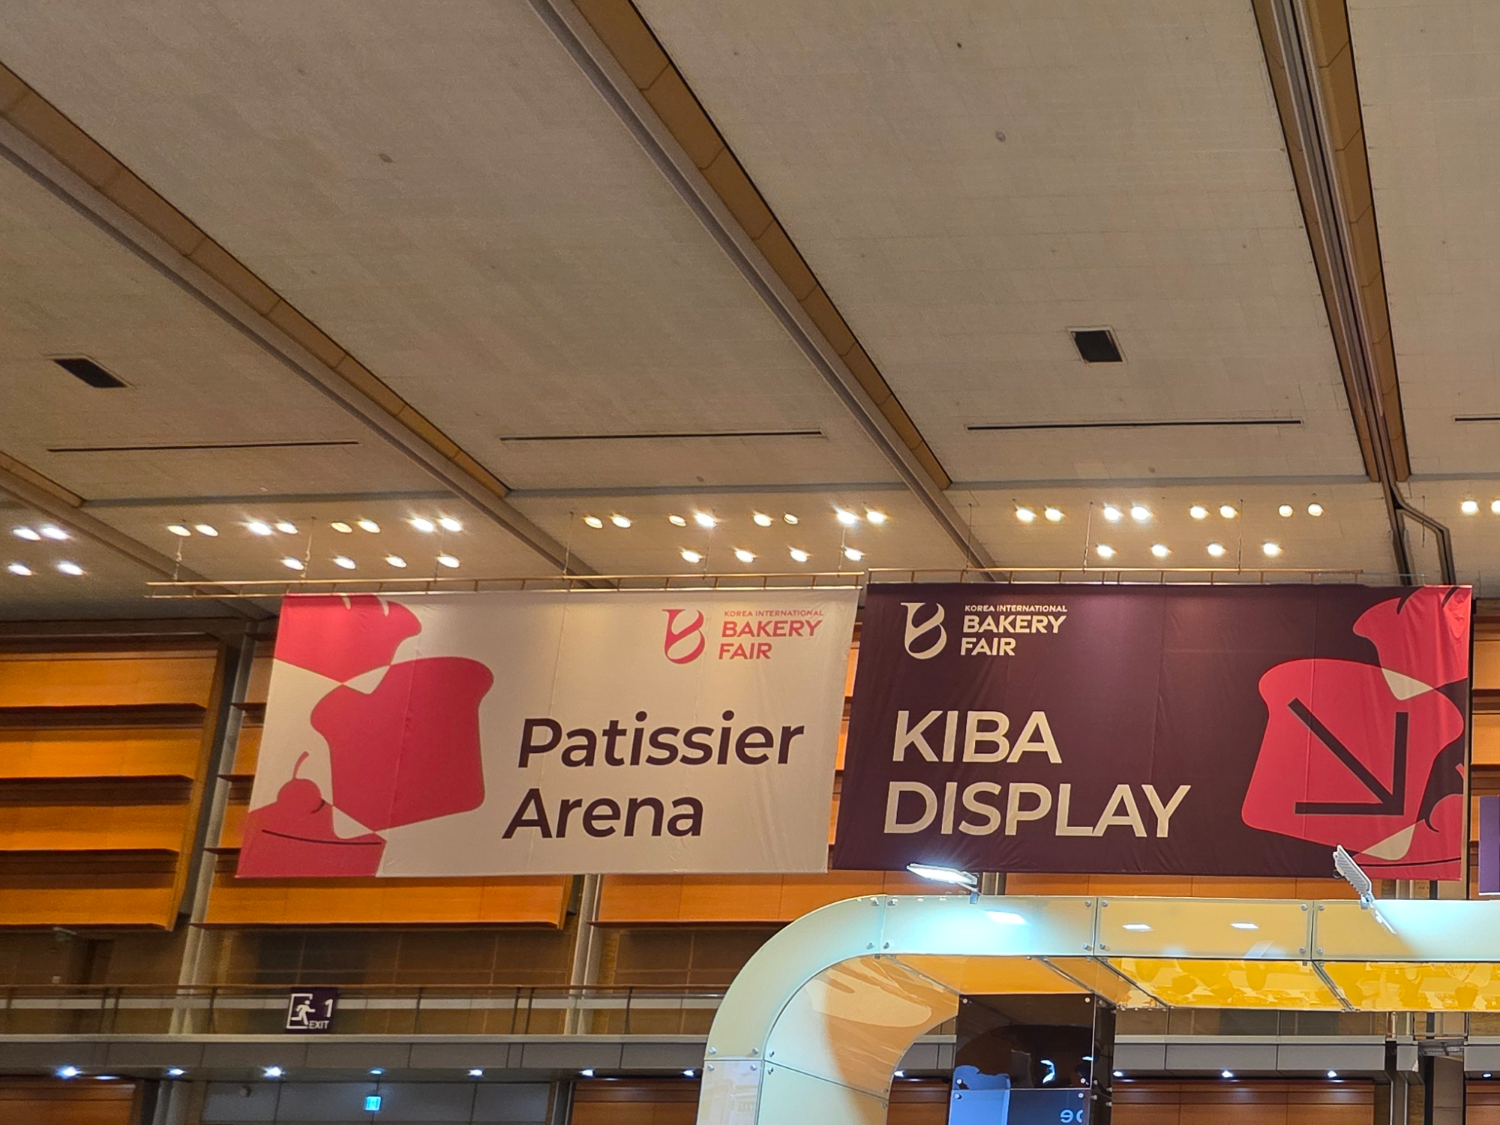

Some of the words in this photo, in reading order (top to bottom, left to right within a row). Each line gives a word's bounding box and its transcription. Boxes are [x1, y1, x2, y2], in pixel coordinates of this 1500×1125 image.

[723, 609, 753, 617] KOREA
[755, 609, 824, 617] INTERNATIONAL
[964, 604, 995, 613] KOREA
[996, 604, 1068, 613] INTERNATIONAL
[721, 619, 823, 638] BAKERY
[963, 614, 1067, 634] BAKERY
[718, 642, 773, 660] FAIR
[960, 637, 1016, 656] FAIR
[517, 709, 805, 769] Patissier
[891, 709, 1063, 765] KIBA
[501, 787, 704, 839] Arena
[883, 780, 1192, 839] DISPLAY
[325, 998, 334, 1018] 1
[308, 1020, 330, 1030] EXIT
